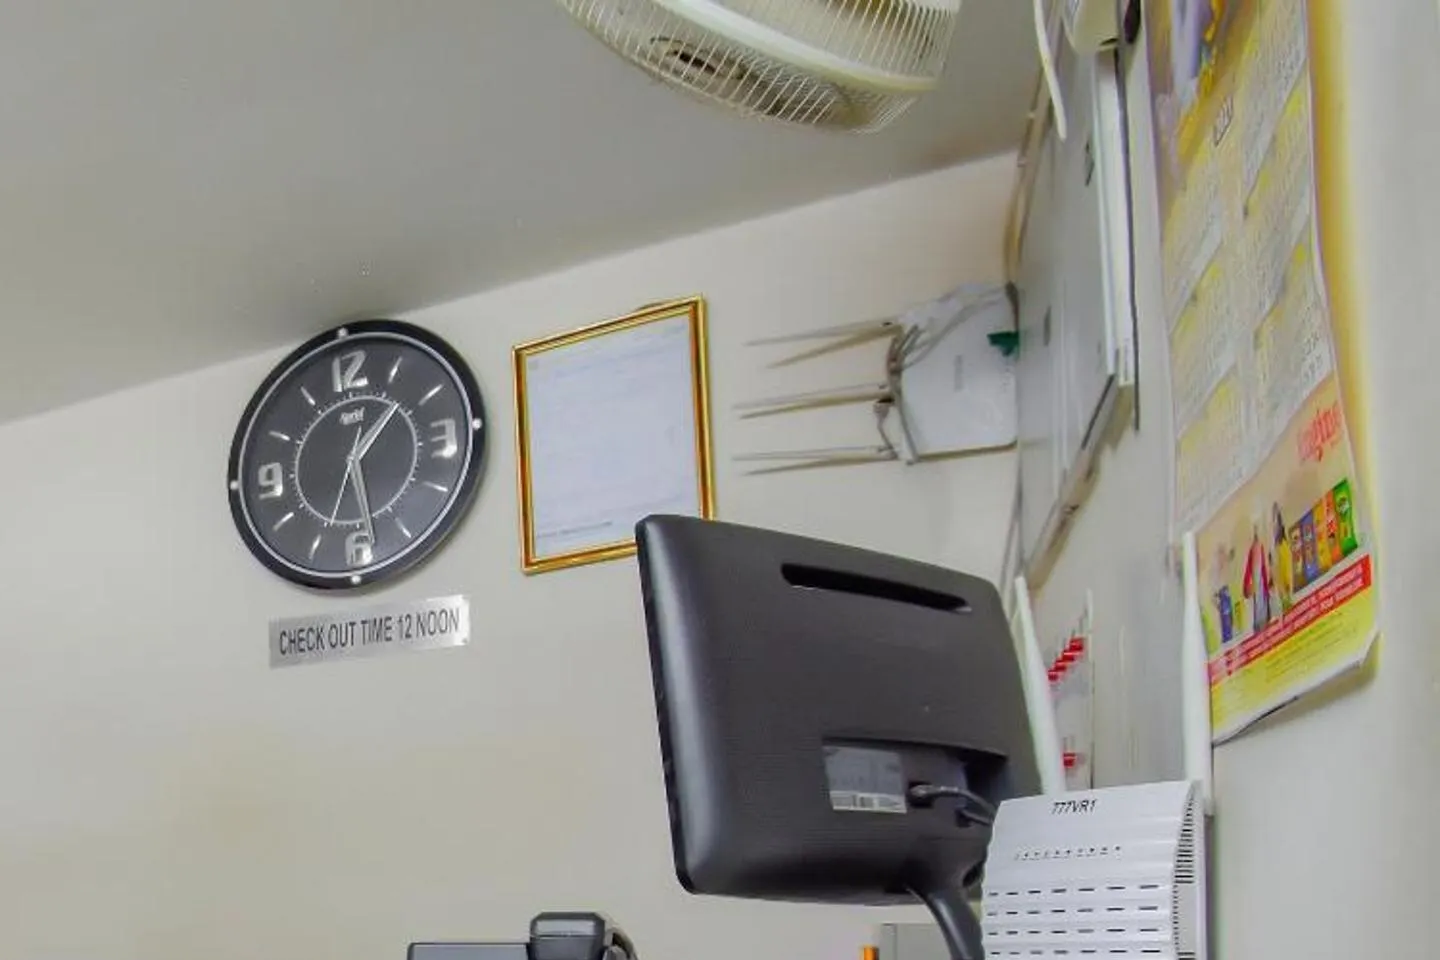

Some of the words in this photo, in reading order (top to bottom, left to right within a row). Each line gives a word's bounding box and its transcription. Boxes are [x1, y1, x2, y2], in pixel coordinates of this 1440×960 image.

[332, 351, 369, 393] 12
[430, 418, 458, 459] 3
[258, 462, 283, 499] 9
[345, 532, 373, 566] 6
[279, 624, 325, 655] CHECK
[328, 621, 357, 648] OUT
[361, 616, 392, 645] TIME
[397, 614, 412, 638] 12
[416, 608, 460, 637] NOON
[1051, 799, 1098, 815] 777VR1
